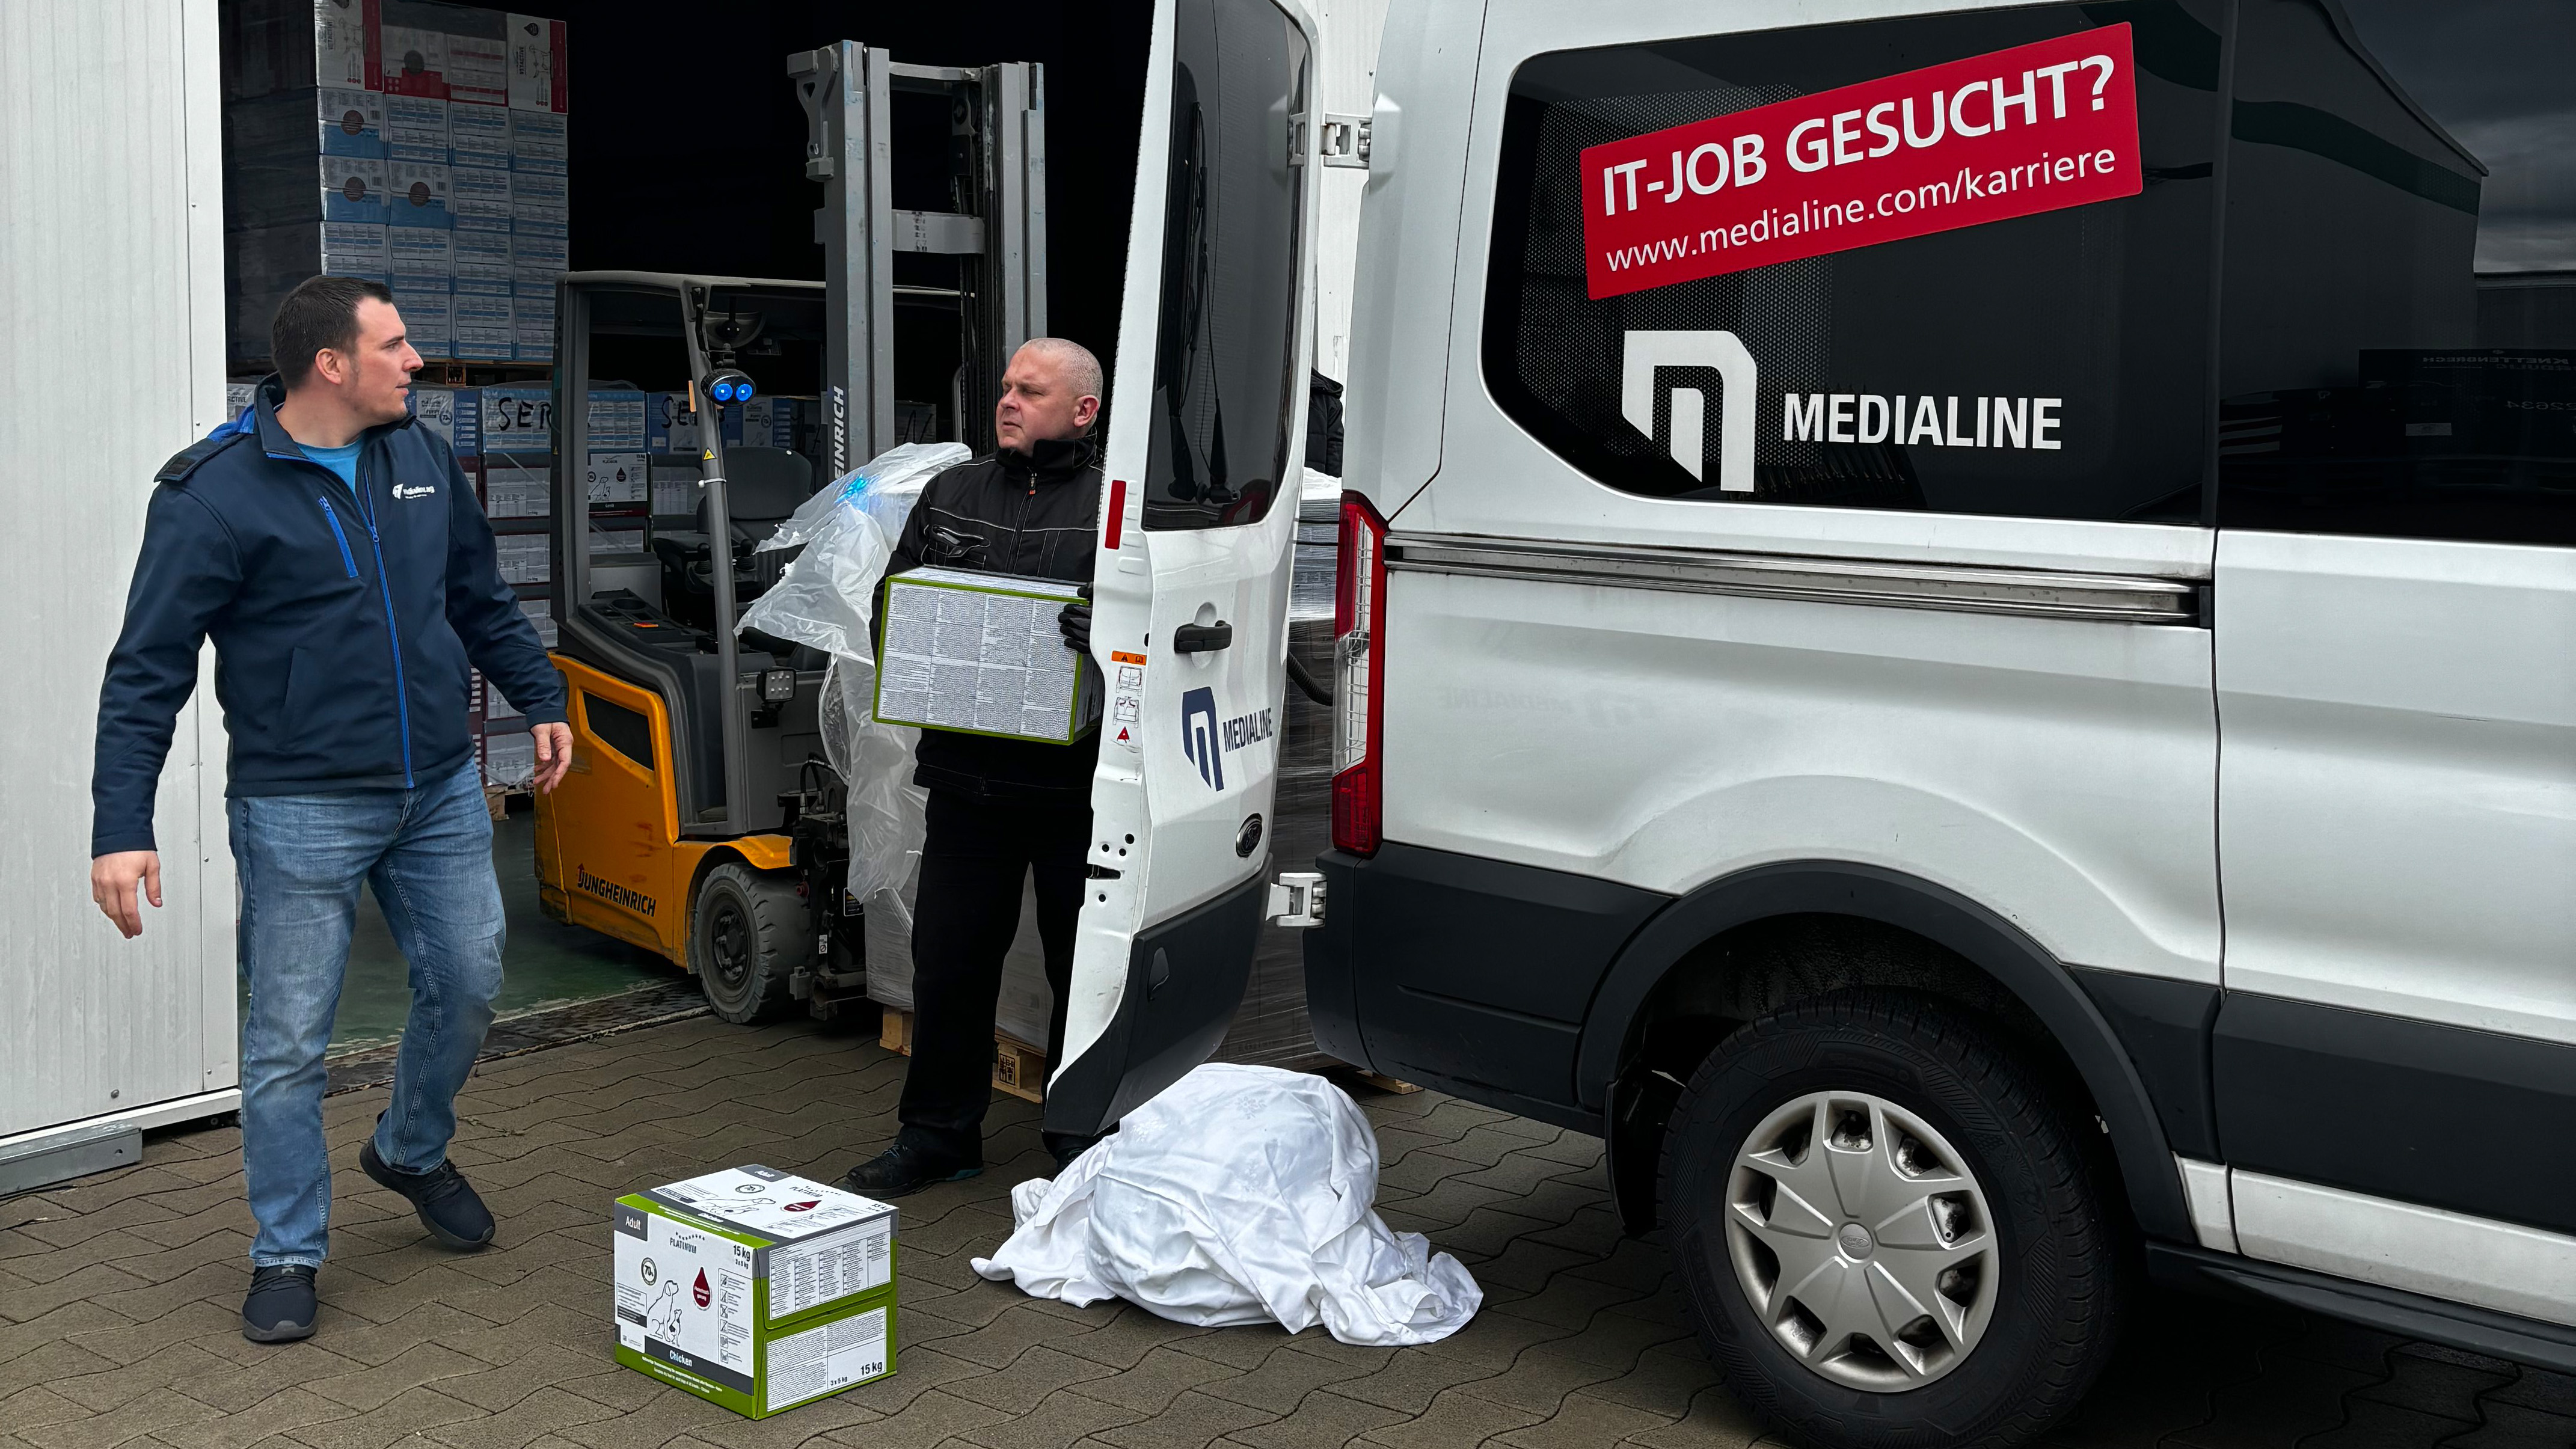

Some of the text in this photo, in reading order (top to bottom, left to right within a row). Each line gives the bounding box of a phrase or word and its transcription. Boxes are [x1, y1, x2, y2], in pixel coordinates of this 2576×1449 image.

[1603, 55, 2115, 216] IT-JOB GESUCHT?
[1606, 149, 2115, 272] www.medialine.com/karriere
[1783, 393, 2062, 450] MEDIALINE
[1222, 706, 1272, 753] MEDIALINE
[577, 868, 657, 917] JUNGHEINRICH
[625, 1215, 641, 1231] Adult
[669, 1237, 697, 1254] PLATINUM
[733, 1245, 750, 1262] 15 kg
[669, 1350, 693, 1367] Chicken
[860, 1361, 883, 1376] 15 kg
